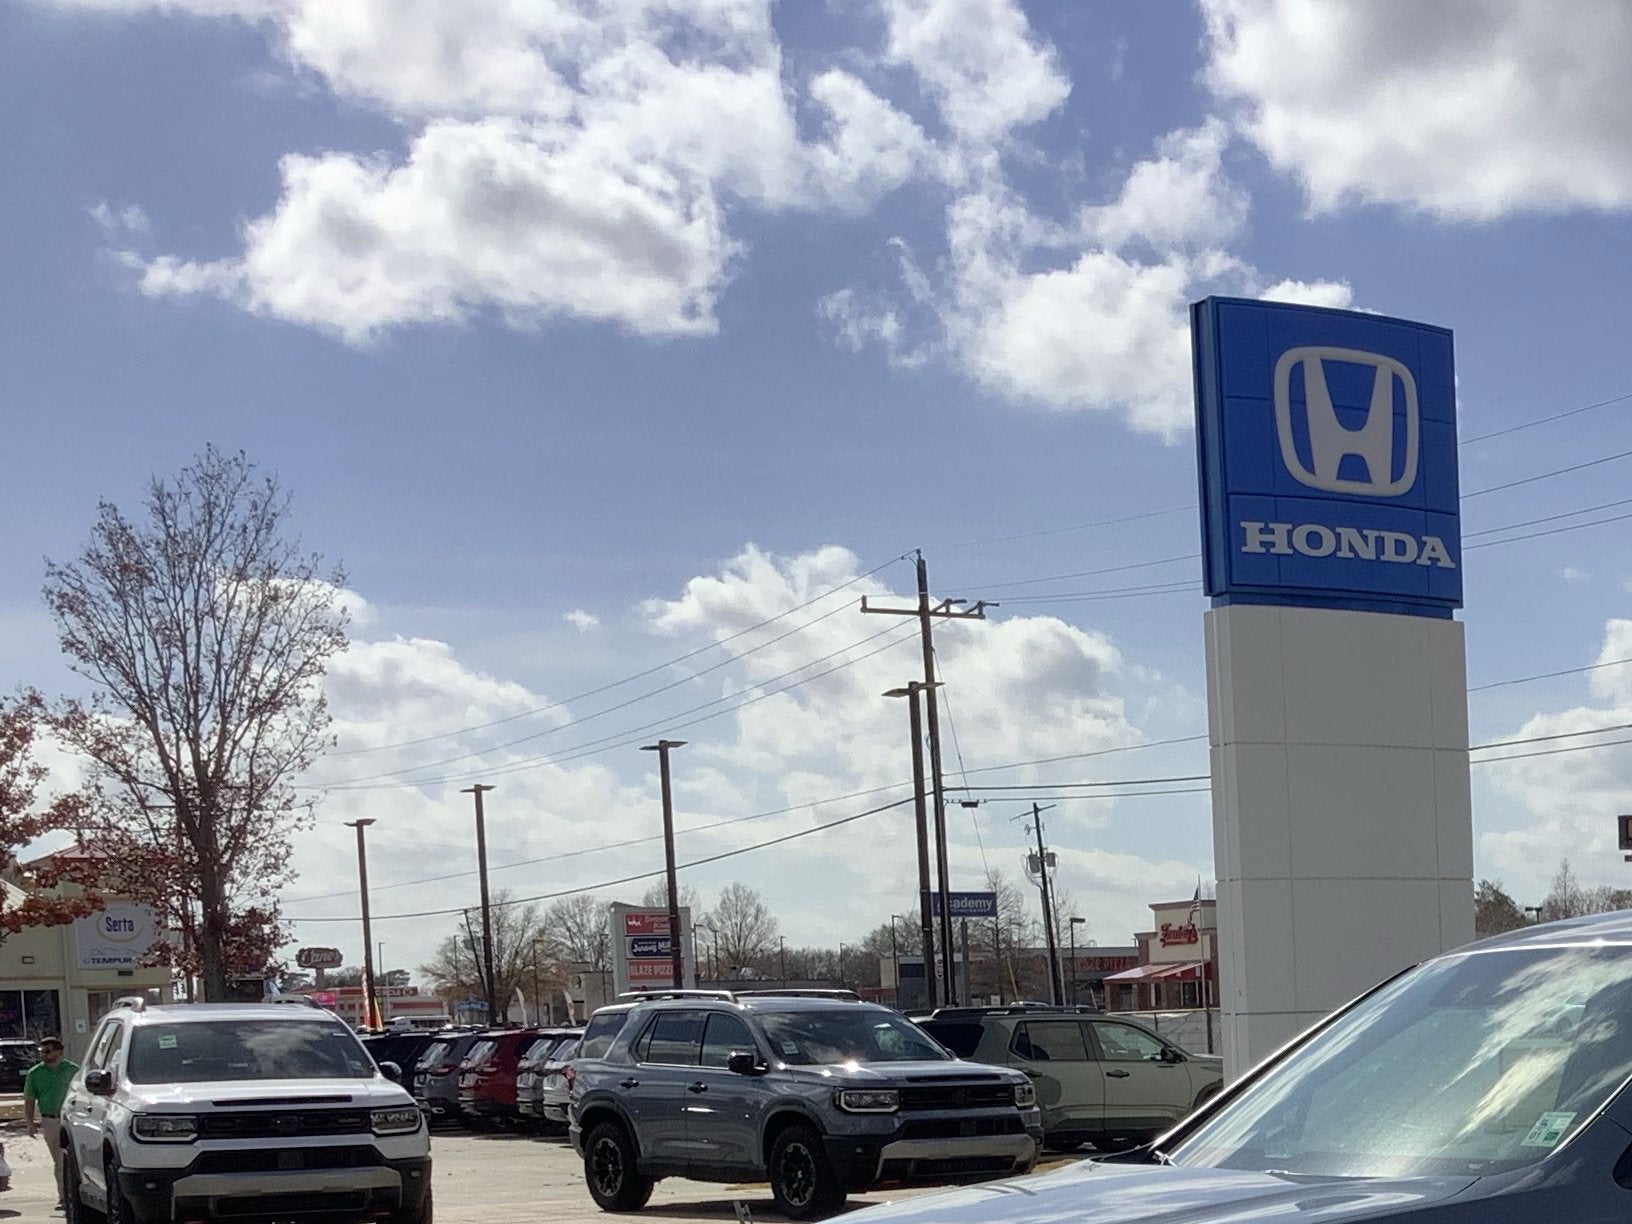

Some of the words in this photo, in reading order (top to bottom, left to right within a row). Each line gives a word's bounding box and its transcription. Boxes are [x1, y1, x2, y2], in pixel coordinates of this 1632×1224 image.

[1240, 521, 1456, 568] HONDA
[105, 917, 134, 932] Serta
[630, 965, 652, 976] BLAZE
[654, 965, 673, 976] PIZZ
